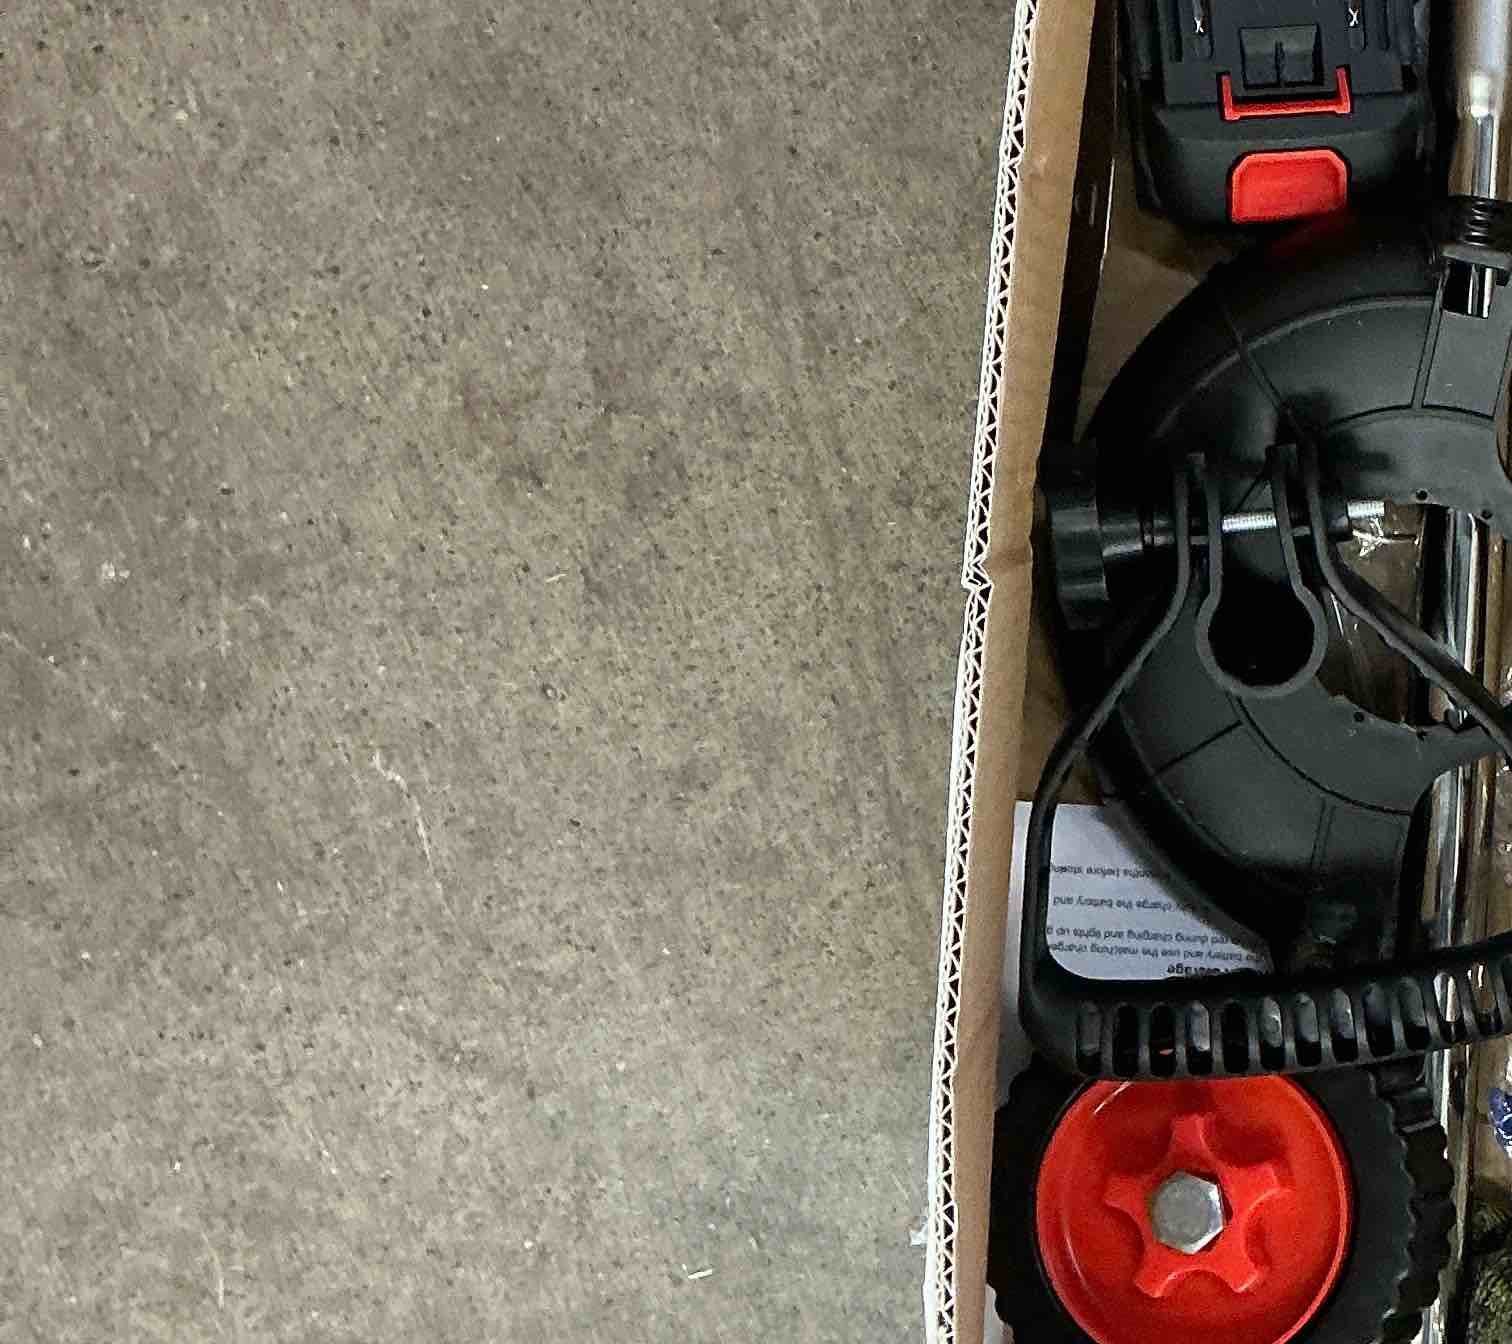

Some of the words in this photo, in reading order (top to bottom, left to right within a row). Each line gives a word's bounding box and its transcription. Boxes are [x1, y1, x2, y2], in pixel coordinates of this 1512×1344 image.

[1053, 897, 1073, 906] and
[1116, 900, 1132, 910] the
[1104, 930, 1122, 940] and
[1128, 929, 1173, 942] charging
[1049, 942, 1087, 954] charge
